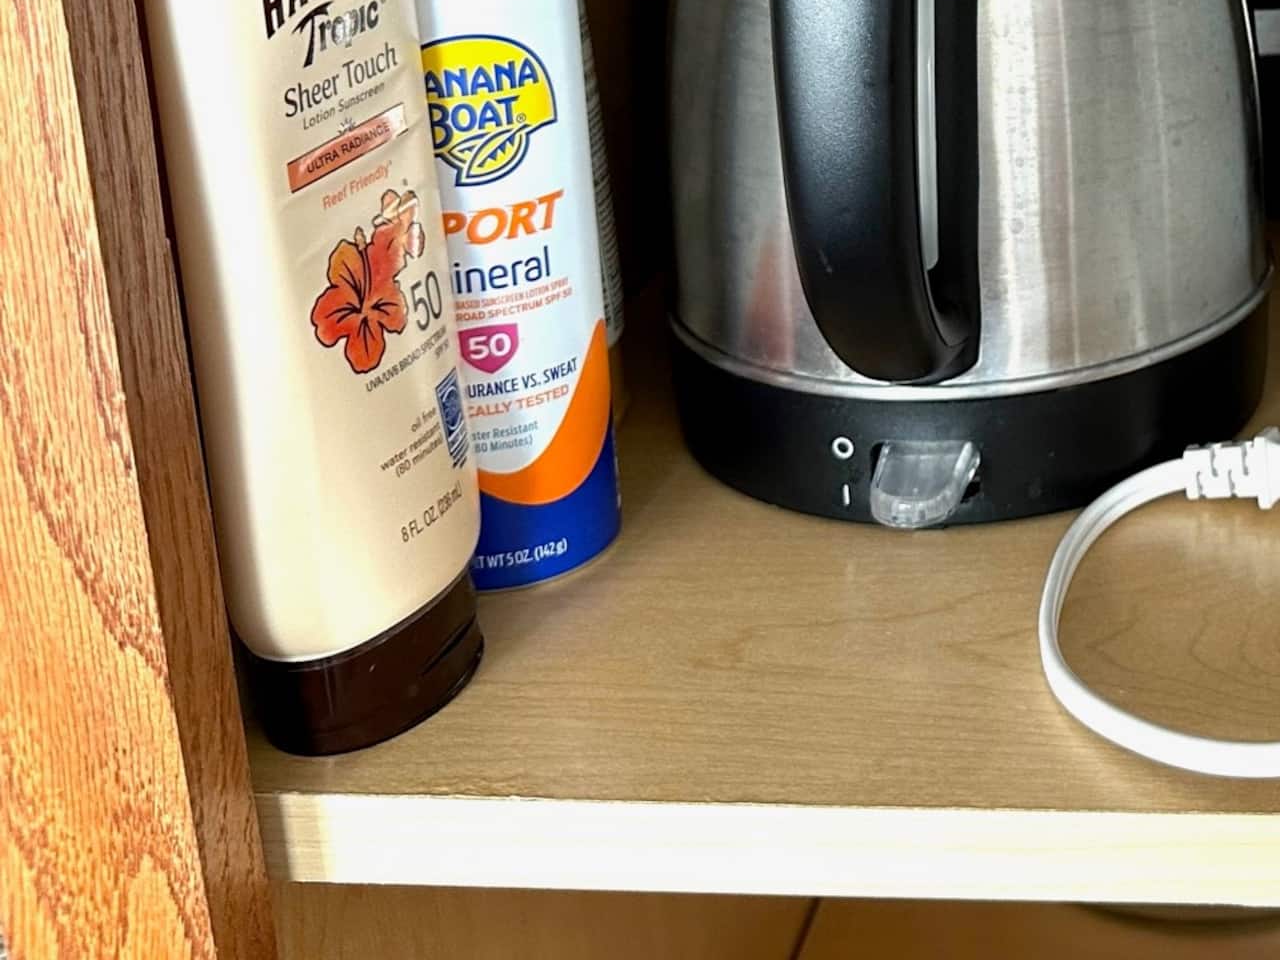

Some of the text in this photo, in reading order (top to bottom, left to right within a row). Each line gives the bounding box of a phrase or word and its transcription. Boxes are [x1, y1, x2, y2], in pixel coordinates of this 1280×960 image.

[284, 42, 398, 118] Sheer Touch
[425, 57, 540, 98] ANANA
[303, 82, 386, 131] Lotion Sunscreen
[430, 95, 520, 150] BOAT
[306, 122, 390, 173] ULTRA RADIANCE
[322, 184, 347, 210] Reef
[442, 190, 564, 245] PORT
[454, 245, 551, 294] ineral
[411, 271, 442, 330] 50
[455, 311, 486, 322] ROAD
[488, 299, 543, 319] SPECTRUM
[468, 332, 512, 360] 50
[467, 357, 578, 399] URANCE VS. SWEAT
[515, 384, 569, 410] TESTED
[492, 420, 538, 438] Resistant
[380, 449, 407, 471] water
[401, 526, 409, 542] 8
